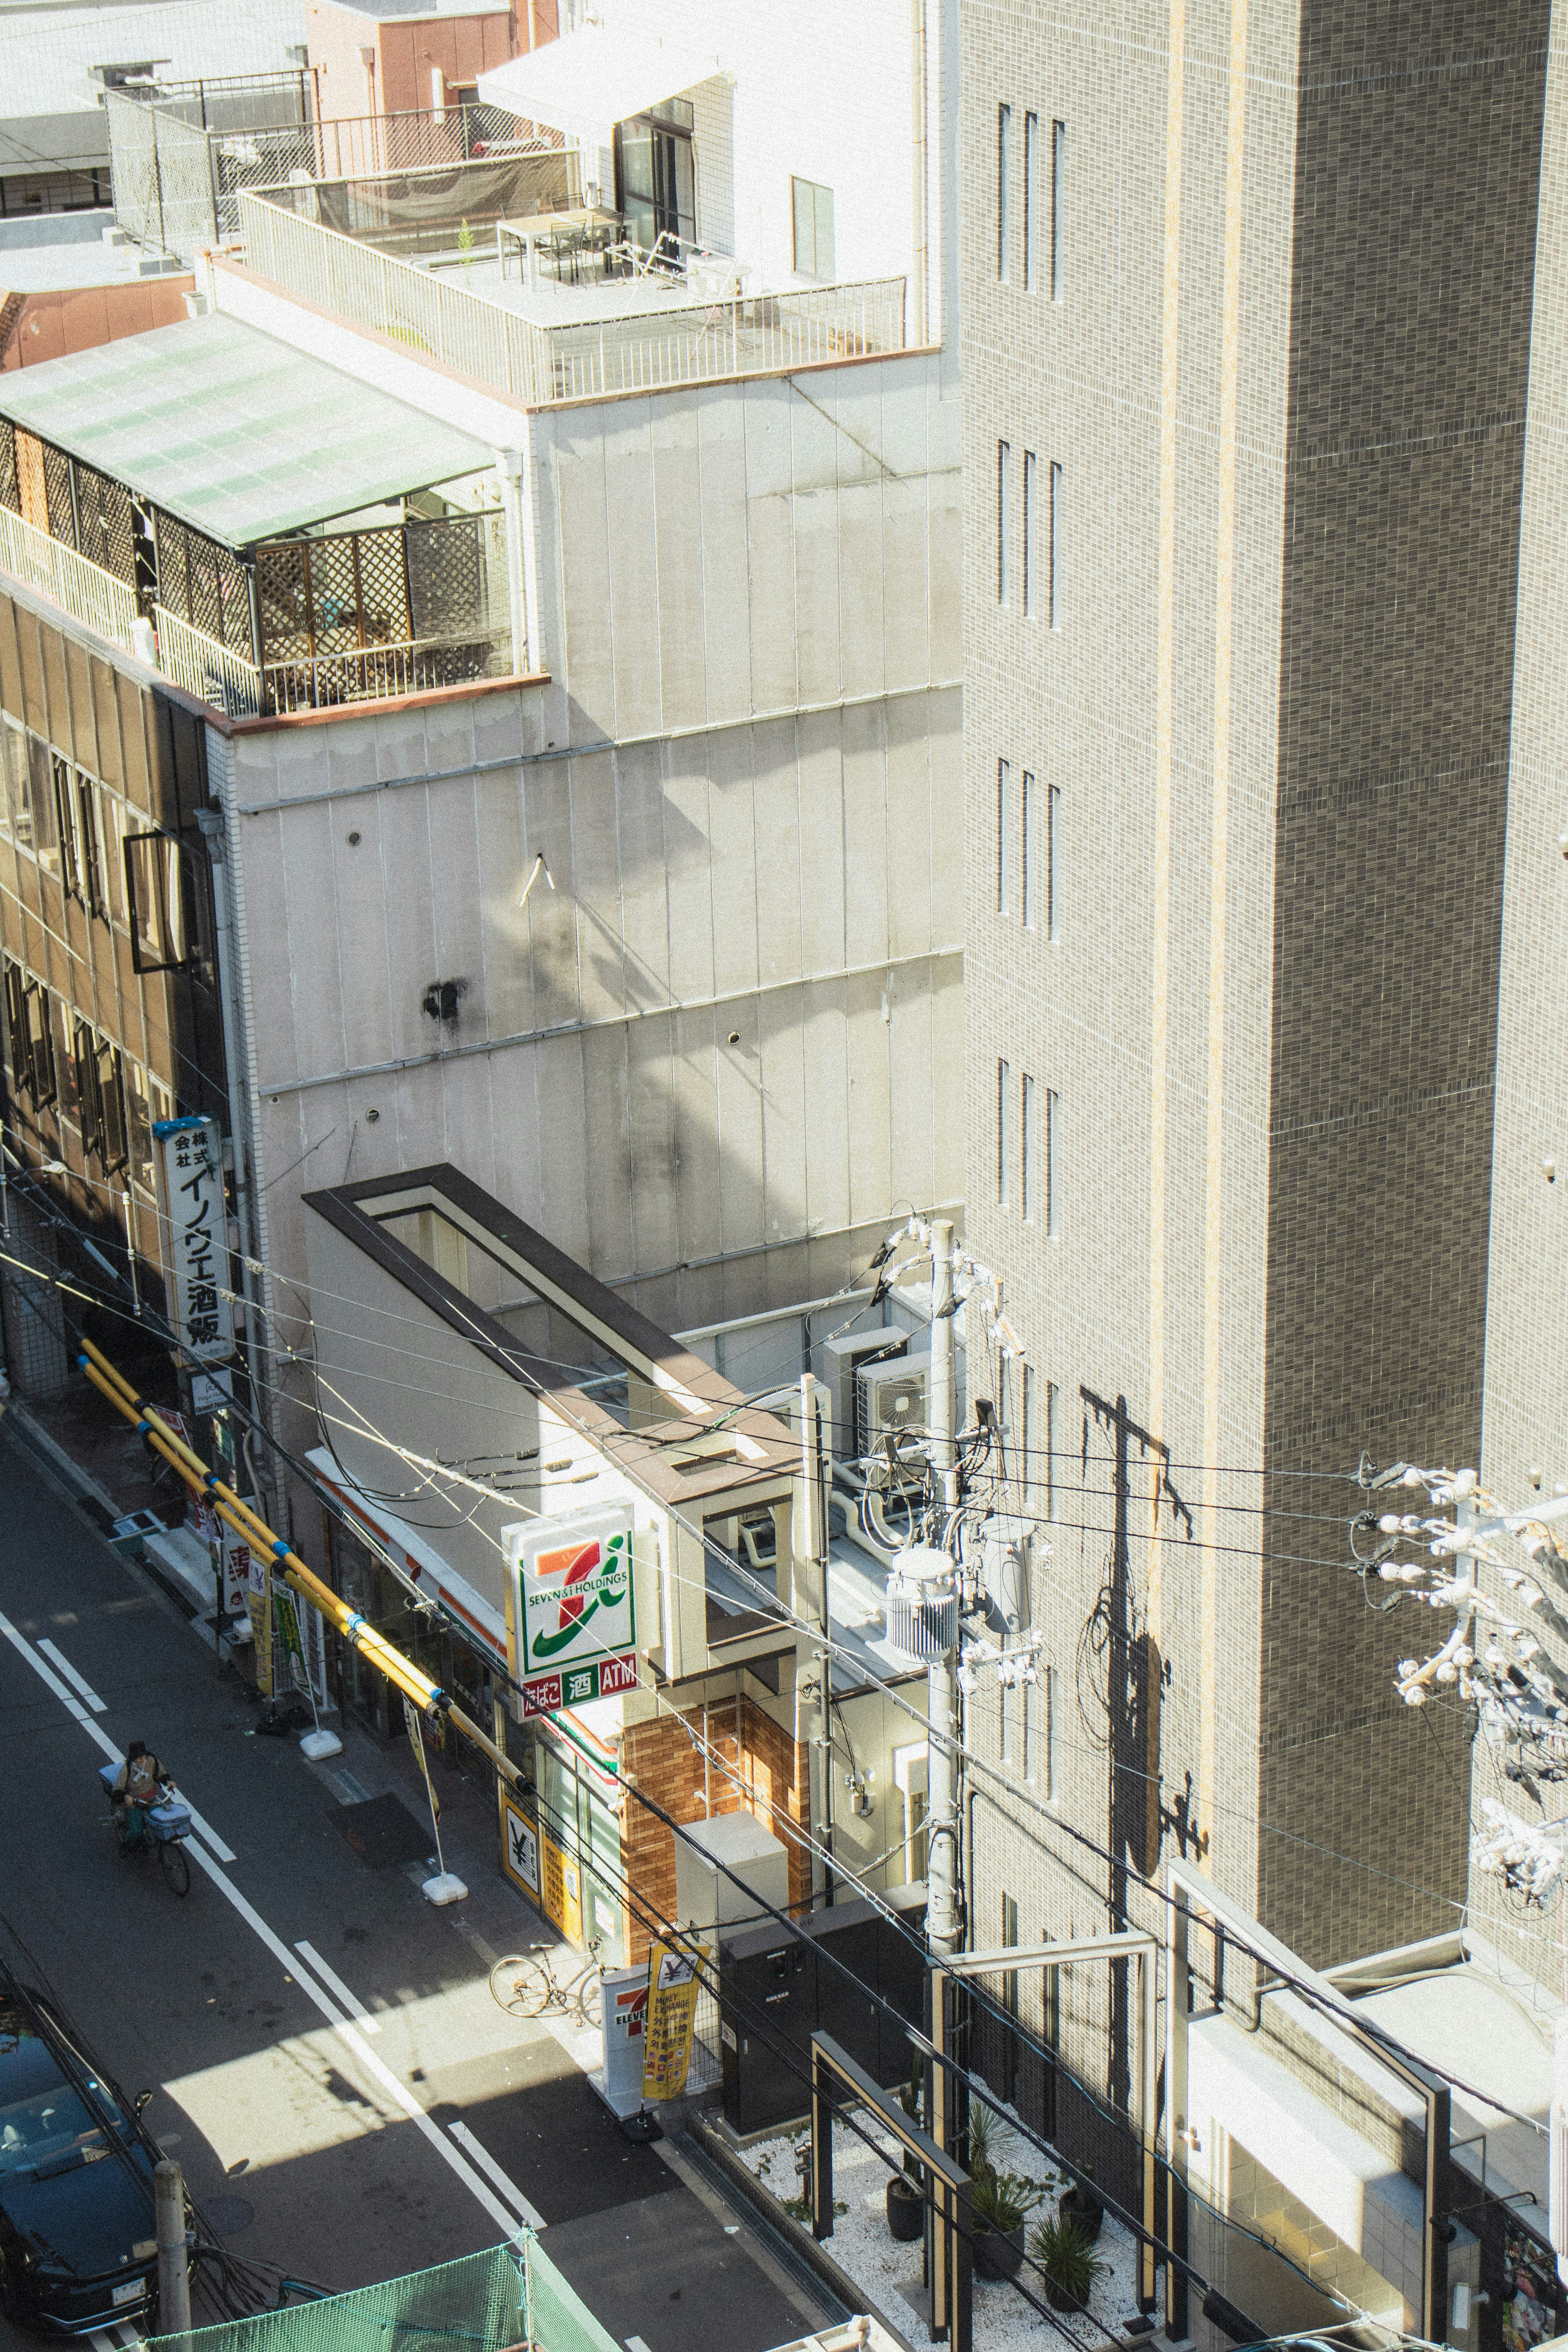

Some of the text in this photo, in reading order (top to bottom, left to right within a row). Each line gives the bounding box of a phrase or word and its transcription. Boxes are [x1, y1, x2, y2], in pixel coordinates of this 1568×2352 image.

[575, 1572, 627, 1594] HOLDINGS
[569, 1671, 592, 1700] 酒
[602, 1659, 634, 1690] ATM
[525, 1682, 560, 1712] たばこ
[655, 1993, 678, 2005] MONEY
